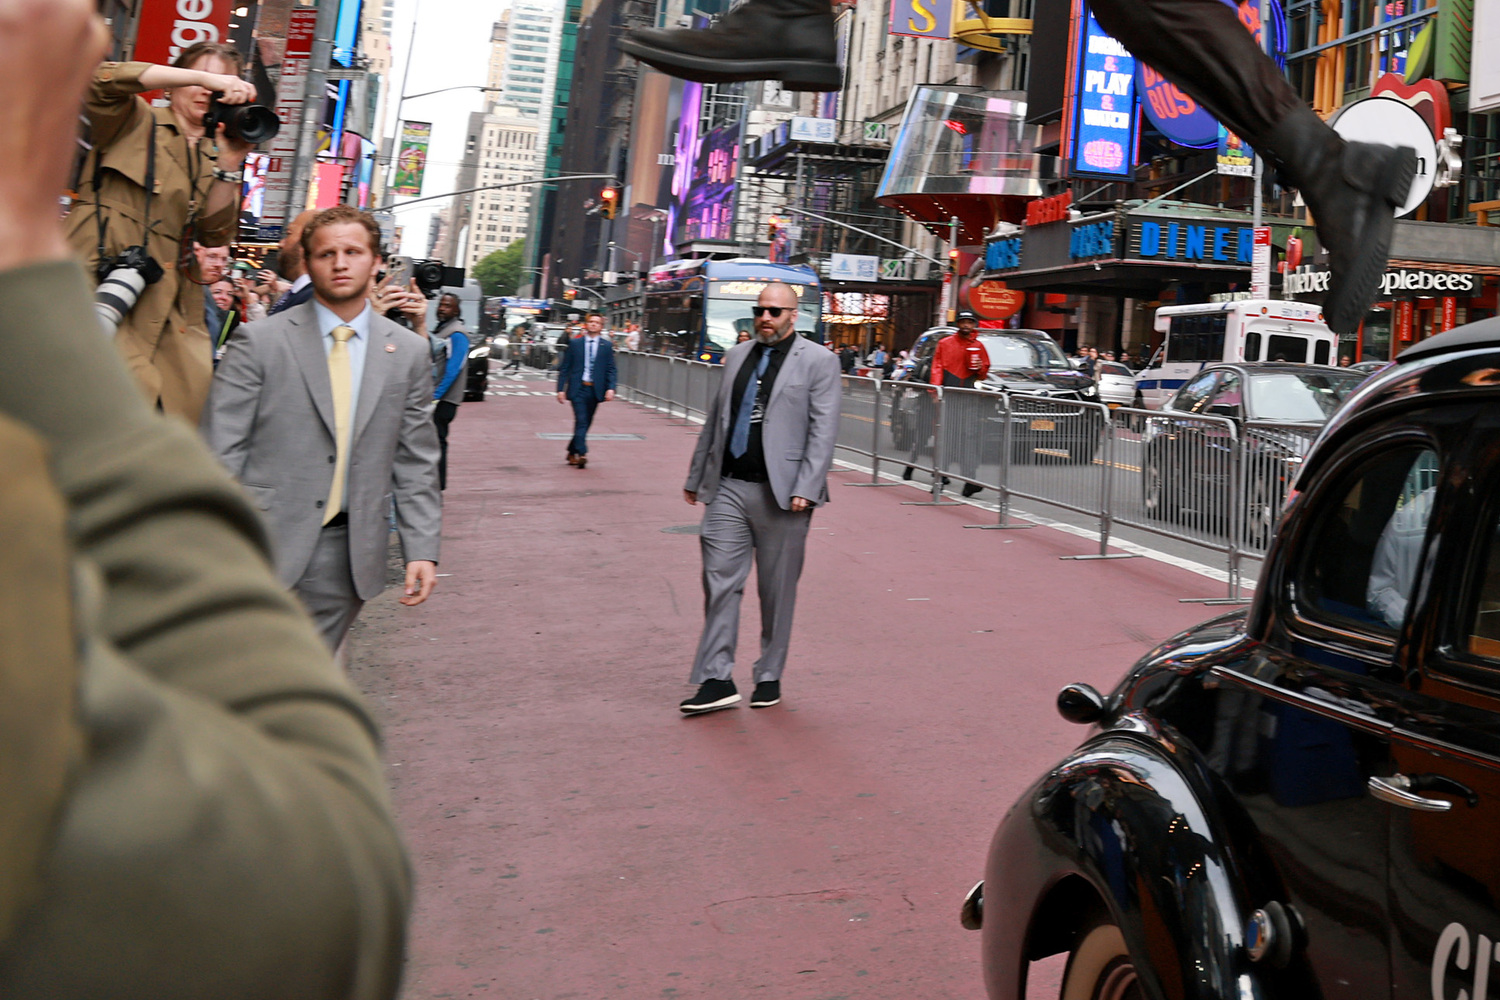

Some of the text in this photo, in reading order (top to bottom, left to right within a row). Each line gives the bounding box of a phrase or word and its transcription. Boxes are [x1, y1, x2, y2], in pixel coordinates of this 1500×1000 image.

[1085, 69, 1132, 96] PLAY
[1083, 108, 1130, 129] WATCH
[1140, 221, 1253, 263] DINER
[1378, 269, 1473, 295] plebees
